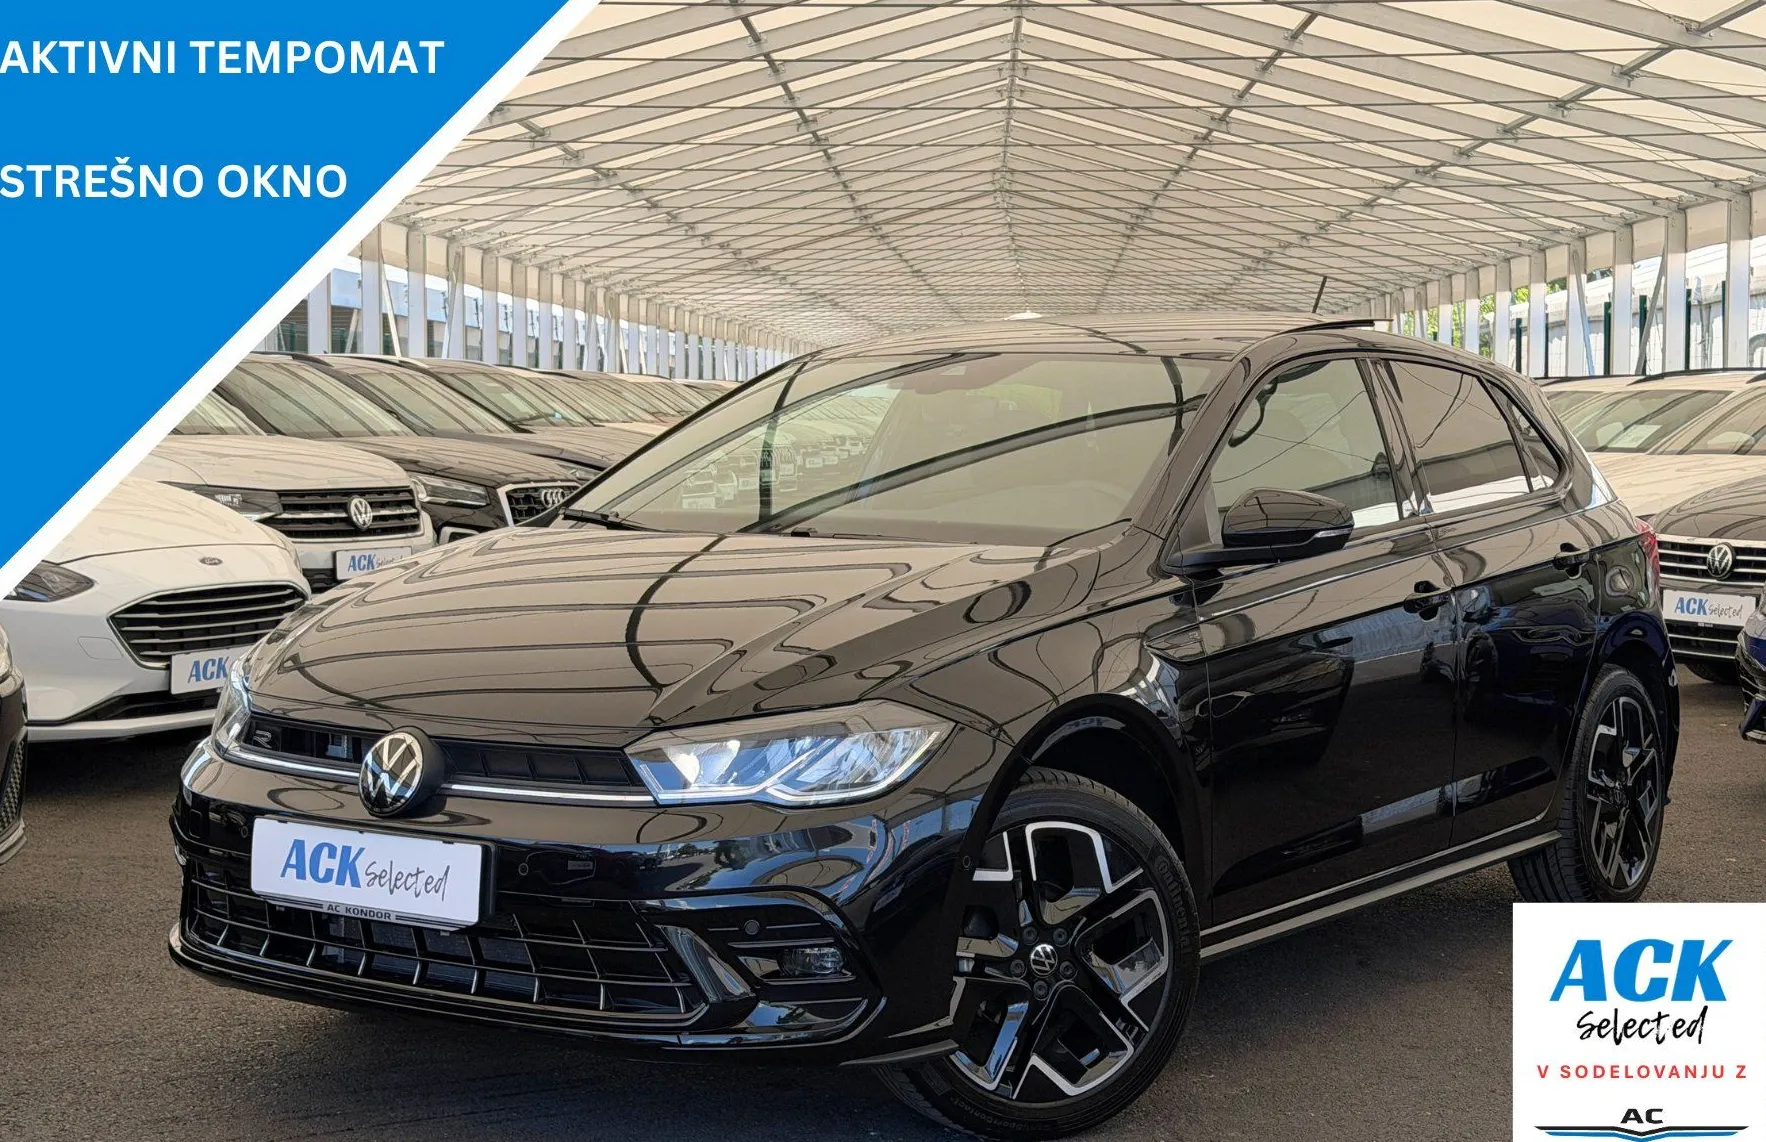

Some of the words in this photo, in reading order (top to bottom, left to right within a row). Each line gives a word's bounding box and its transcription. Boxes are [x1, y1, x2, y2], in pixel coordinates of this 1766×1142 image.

[347, 553, 376, 572] ACK
[1674, 596, 1709, 616] ACK
[1708, 603, 1743, 619] Selected
[187, 656, 229, 683] ACK
[280, 838, 366, 889] ACK
[364, 860, 451, 902] Selected
[327, 904, 341, 913] AC
[345, 906, 392, 921] KONDOR
